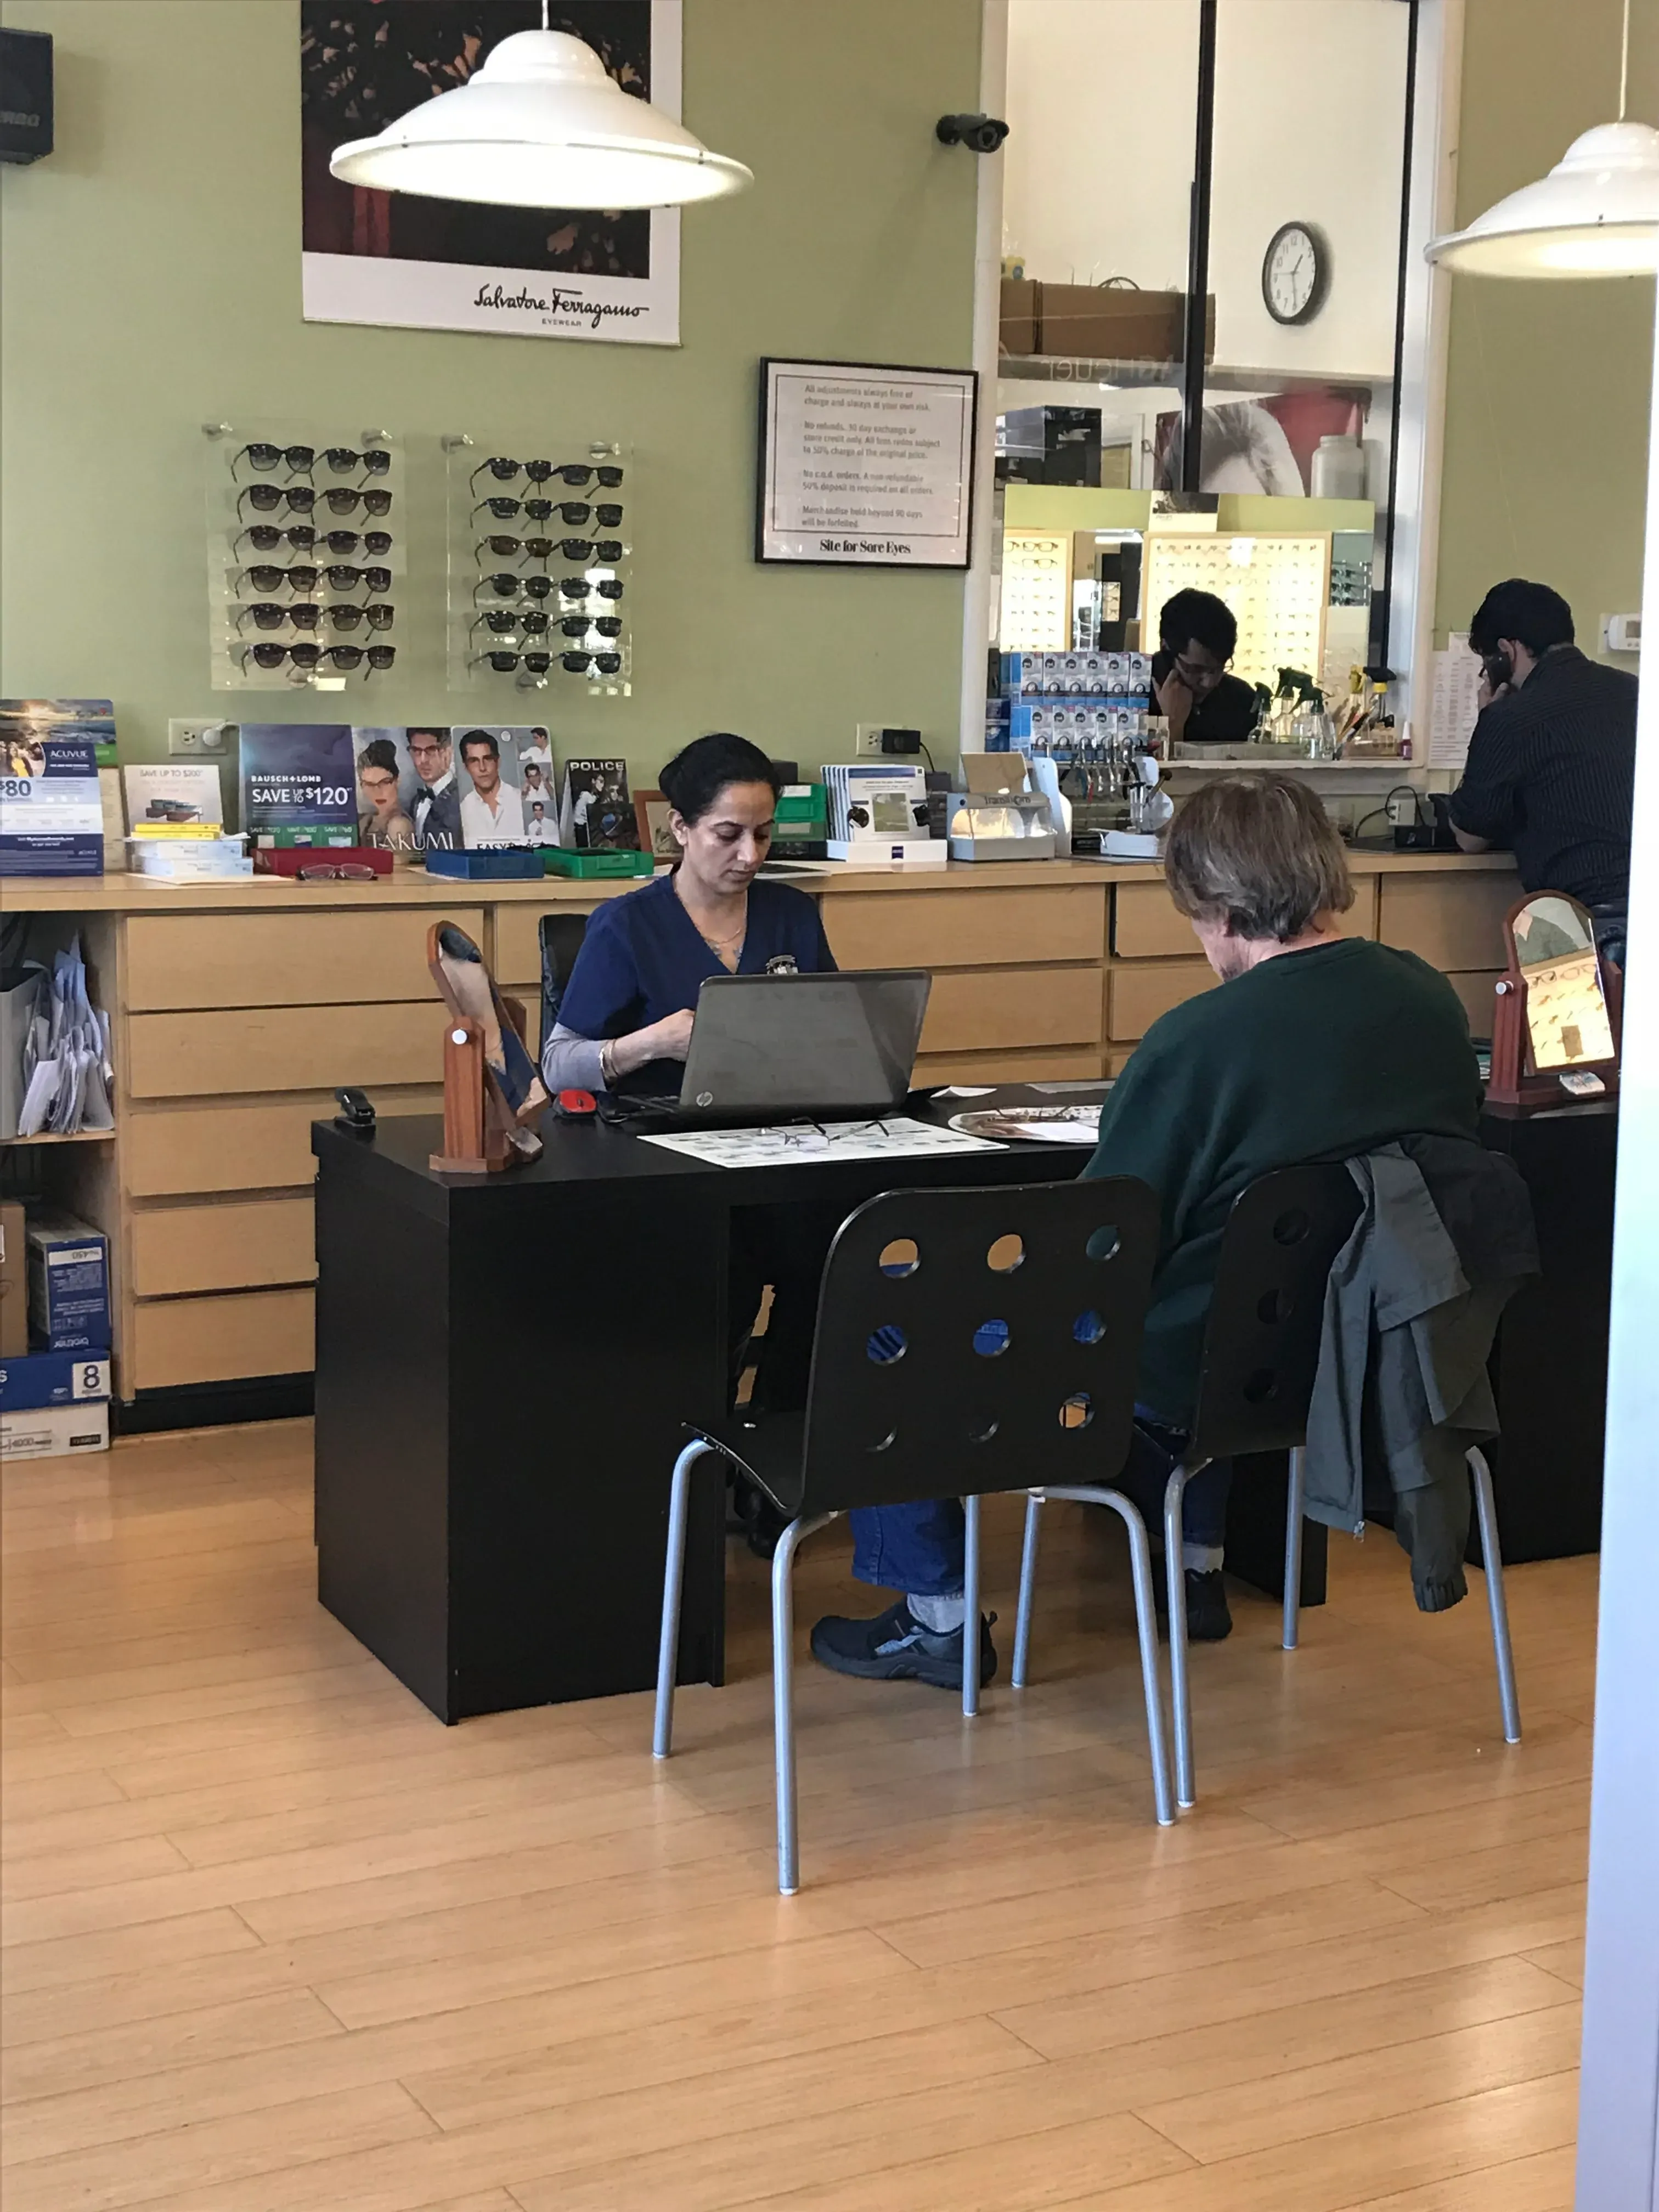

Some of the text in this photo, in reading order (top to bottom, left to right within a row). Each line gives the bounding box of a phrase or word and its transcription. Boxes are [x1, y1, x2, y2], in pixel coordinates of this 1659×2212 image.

[474, 284, 649, 329] Salvatore Ferragamo
[816, 386, 861, 395] adjustments
[864, 387, 888, 398] always
[890, 389, 903, 398] free
[805, 397, 829, 407] charge
[847, 399, 871, 409] always
[882, 402, 898, 410] your
[804, 421, 815, 429] No
[859, 424, 872, 433] day
[874, 426, 907, 435] exchange
[915, 439, 940, 448] subject
[813, 447, 828, 455] 50%
[831, 447, 855, 457] charge
[879, 450, 906, 459] original
[821, 483, 847, 493] deposit
[857, 485, 887, 493] required
[850, 507, 866, 516] held
[868, 508, 894, 518] beyond
[906, 511, 923, 519] days
[817, 518, 826, 527] be
[820, 538, 911, 555] Site for Sore Eyes
[570, 761, 624, 771] POLICE
[252, 788, 291, 803] SAVE
[366, 832, 454, 850] TAKUMI
[83, 1365, 100, 1389] 8
